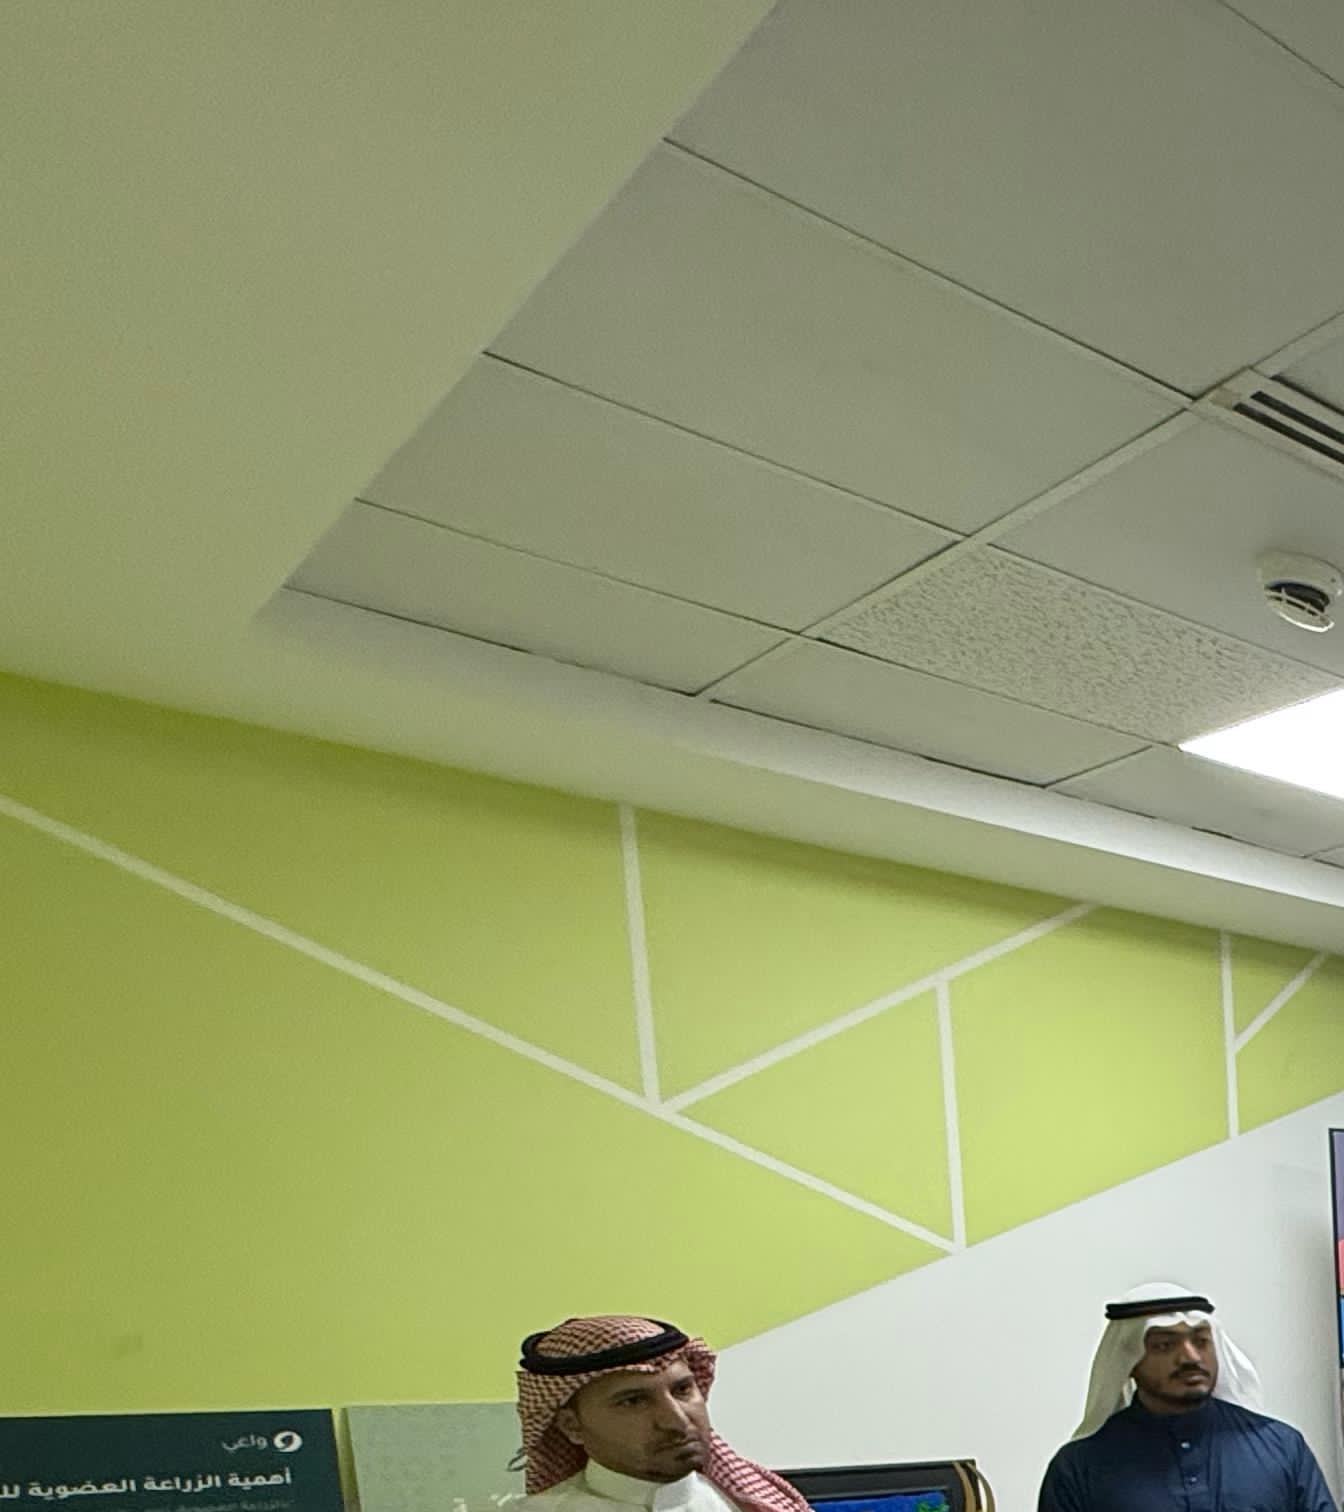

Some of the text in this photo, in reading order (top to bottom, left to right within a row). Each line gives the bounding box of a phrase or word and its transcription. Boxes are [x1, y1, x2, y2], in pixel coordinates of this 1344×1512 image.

[144, 1475, 221, 1494] الزراعة
[228, 1468, 292, 1488] أهمية
[28, 1478, 137, 1500] العضوية
